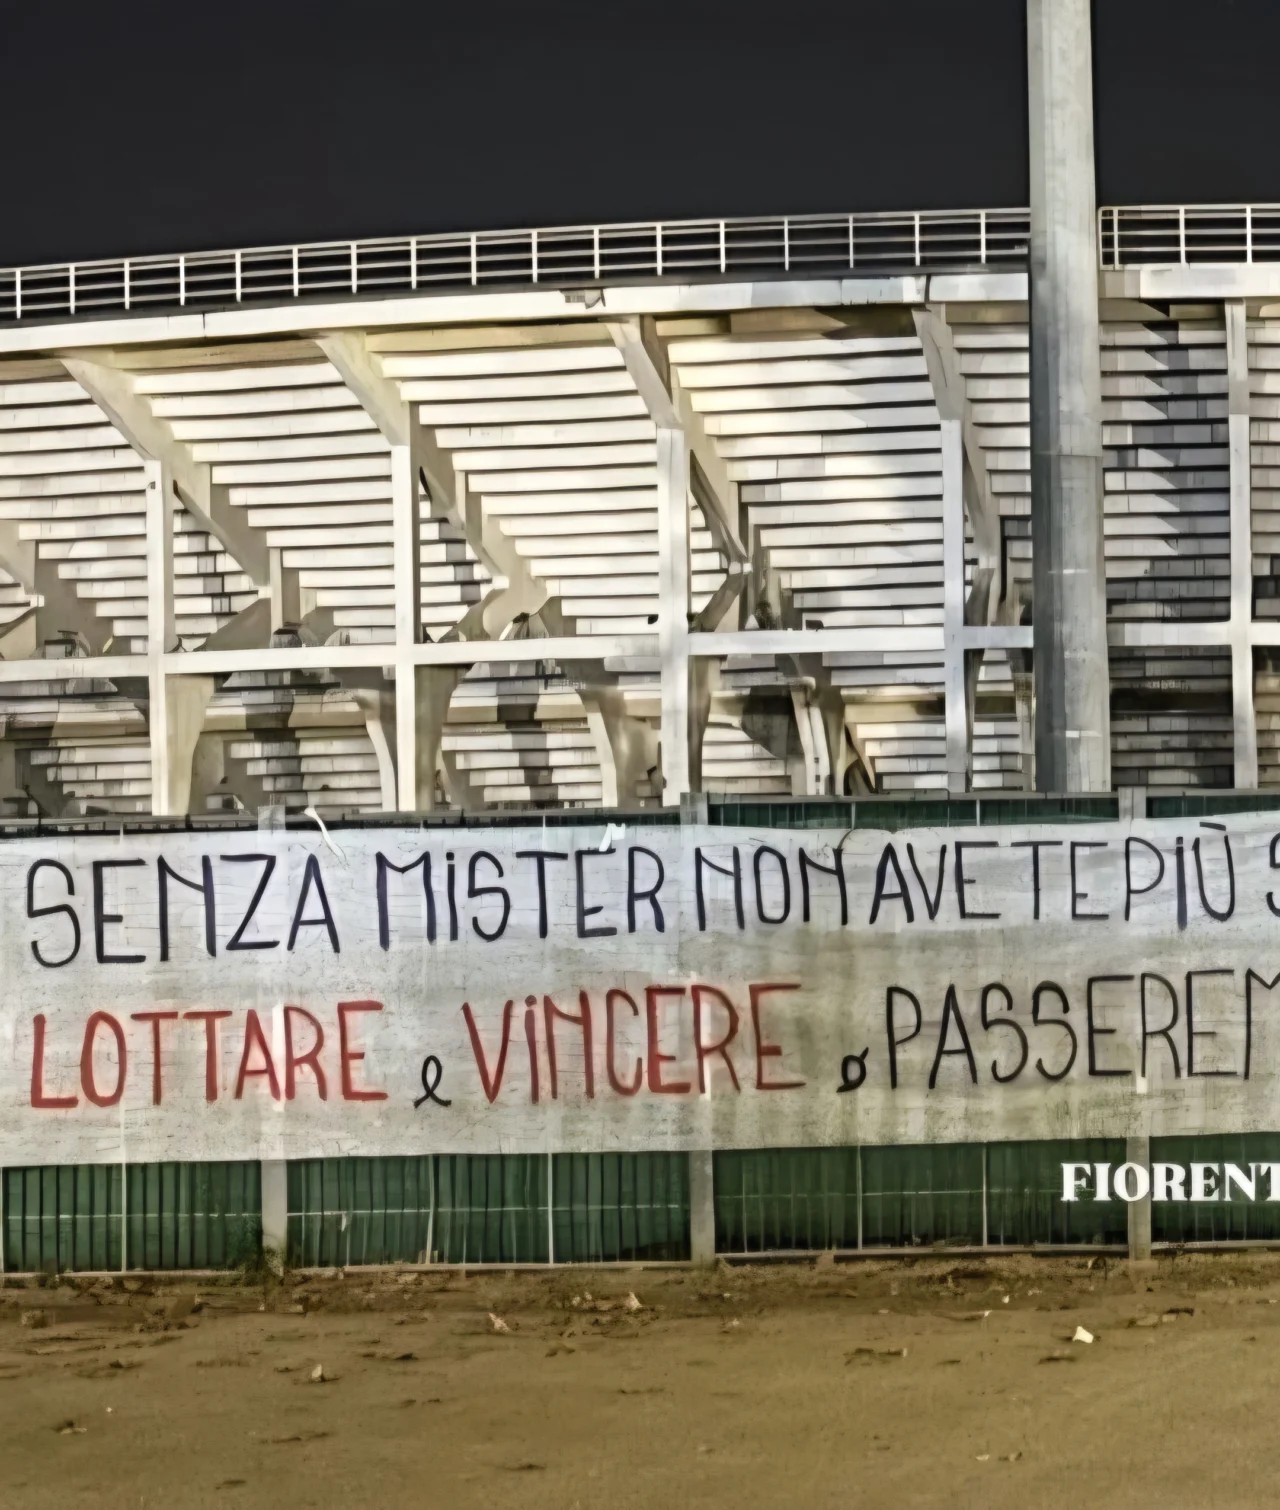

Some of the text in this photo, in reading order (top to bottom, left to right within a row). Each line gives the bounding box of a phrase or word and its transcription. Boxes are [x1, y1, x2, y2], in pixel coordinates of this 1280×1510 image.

[26, 852, 341, 969] SENZA
[695, 845, 848, 932] NON
[30, 1000, 389, 1110] LOTTARE
[413, 1055, 452, 1109] e
